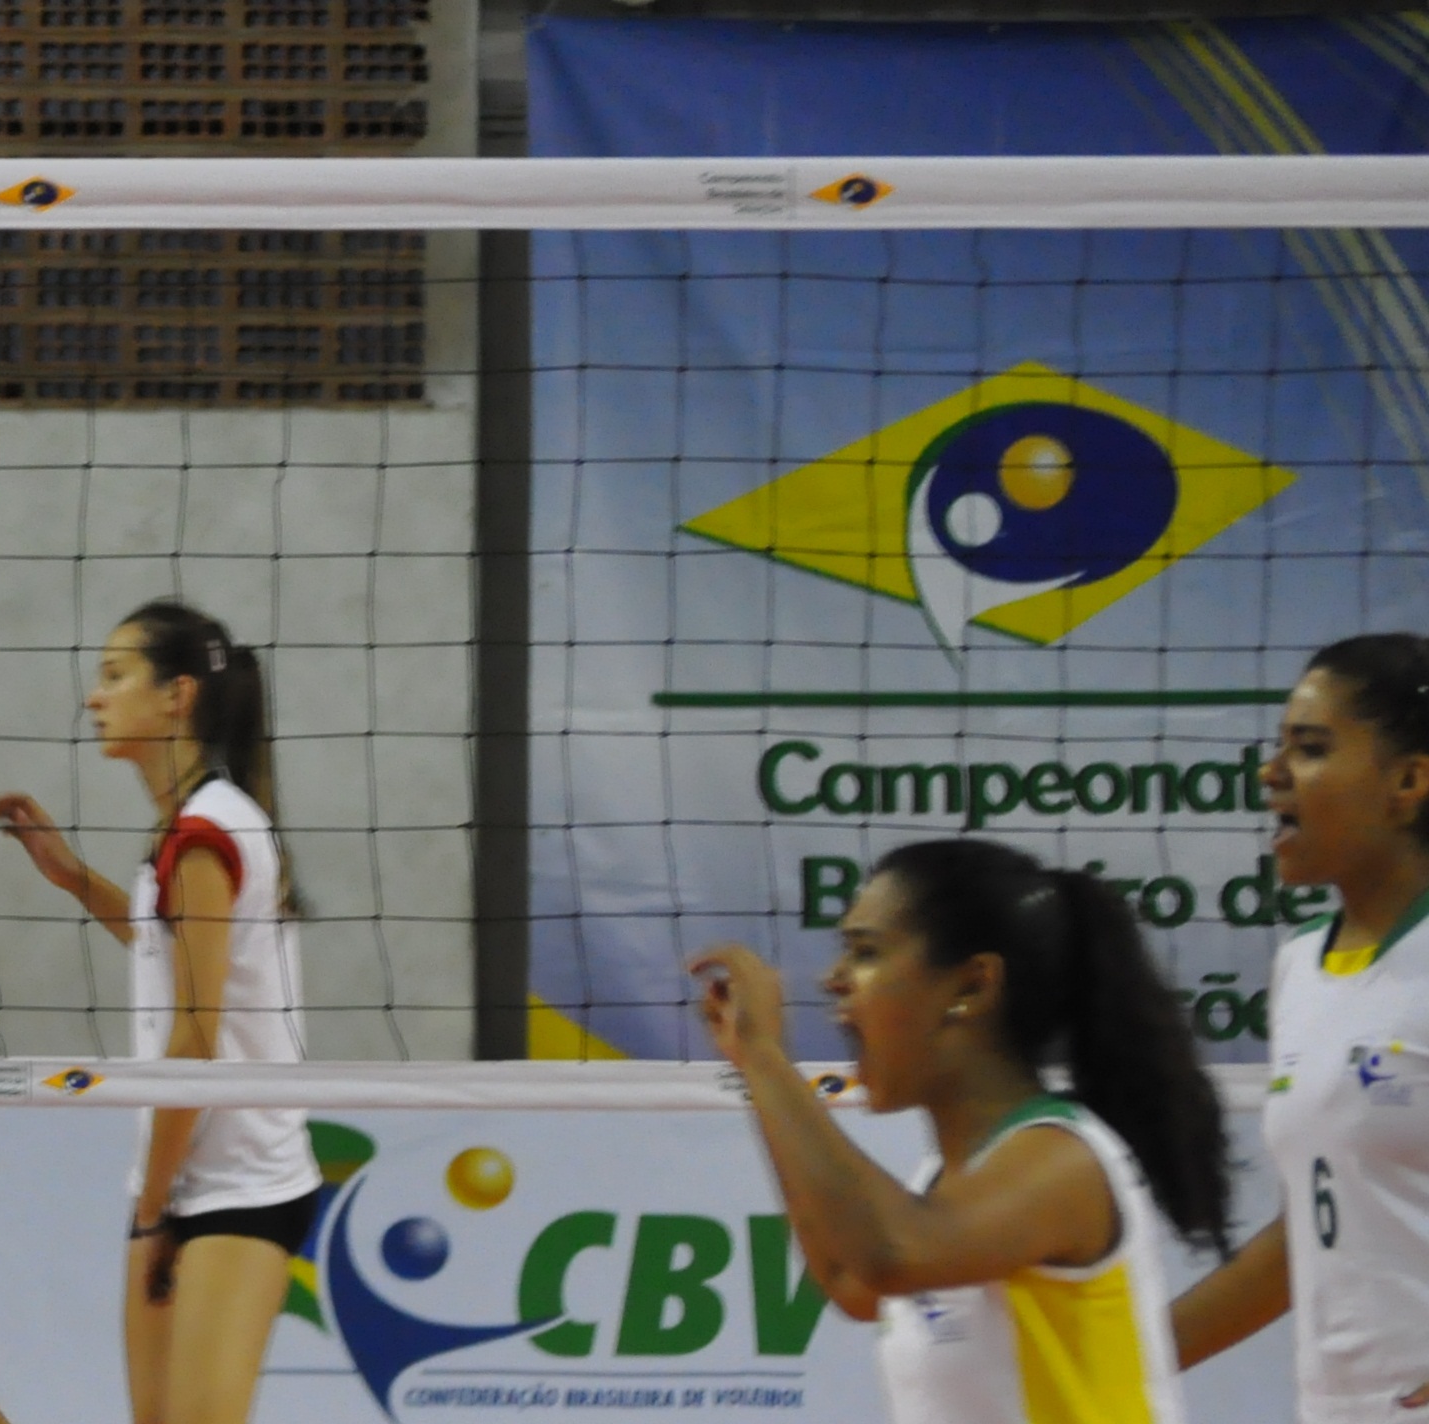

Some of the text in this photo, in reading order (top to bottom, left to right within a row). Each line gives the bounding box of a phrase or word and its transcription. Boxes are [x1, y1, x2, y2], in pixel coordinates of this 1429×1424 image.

[759, 740, 1269, 831] Campeonat
[1219, 854, 1331, 927] de
[1312, 1156, 1339, 1249] 6
[518, 1209, 831, 1358] CBV
[563, 1387, 675, 1409] BRASILEIRA
[679, 1387, 705, 1409] DE
[712, 1387, 805, 1409] VOLEIBOL
